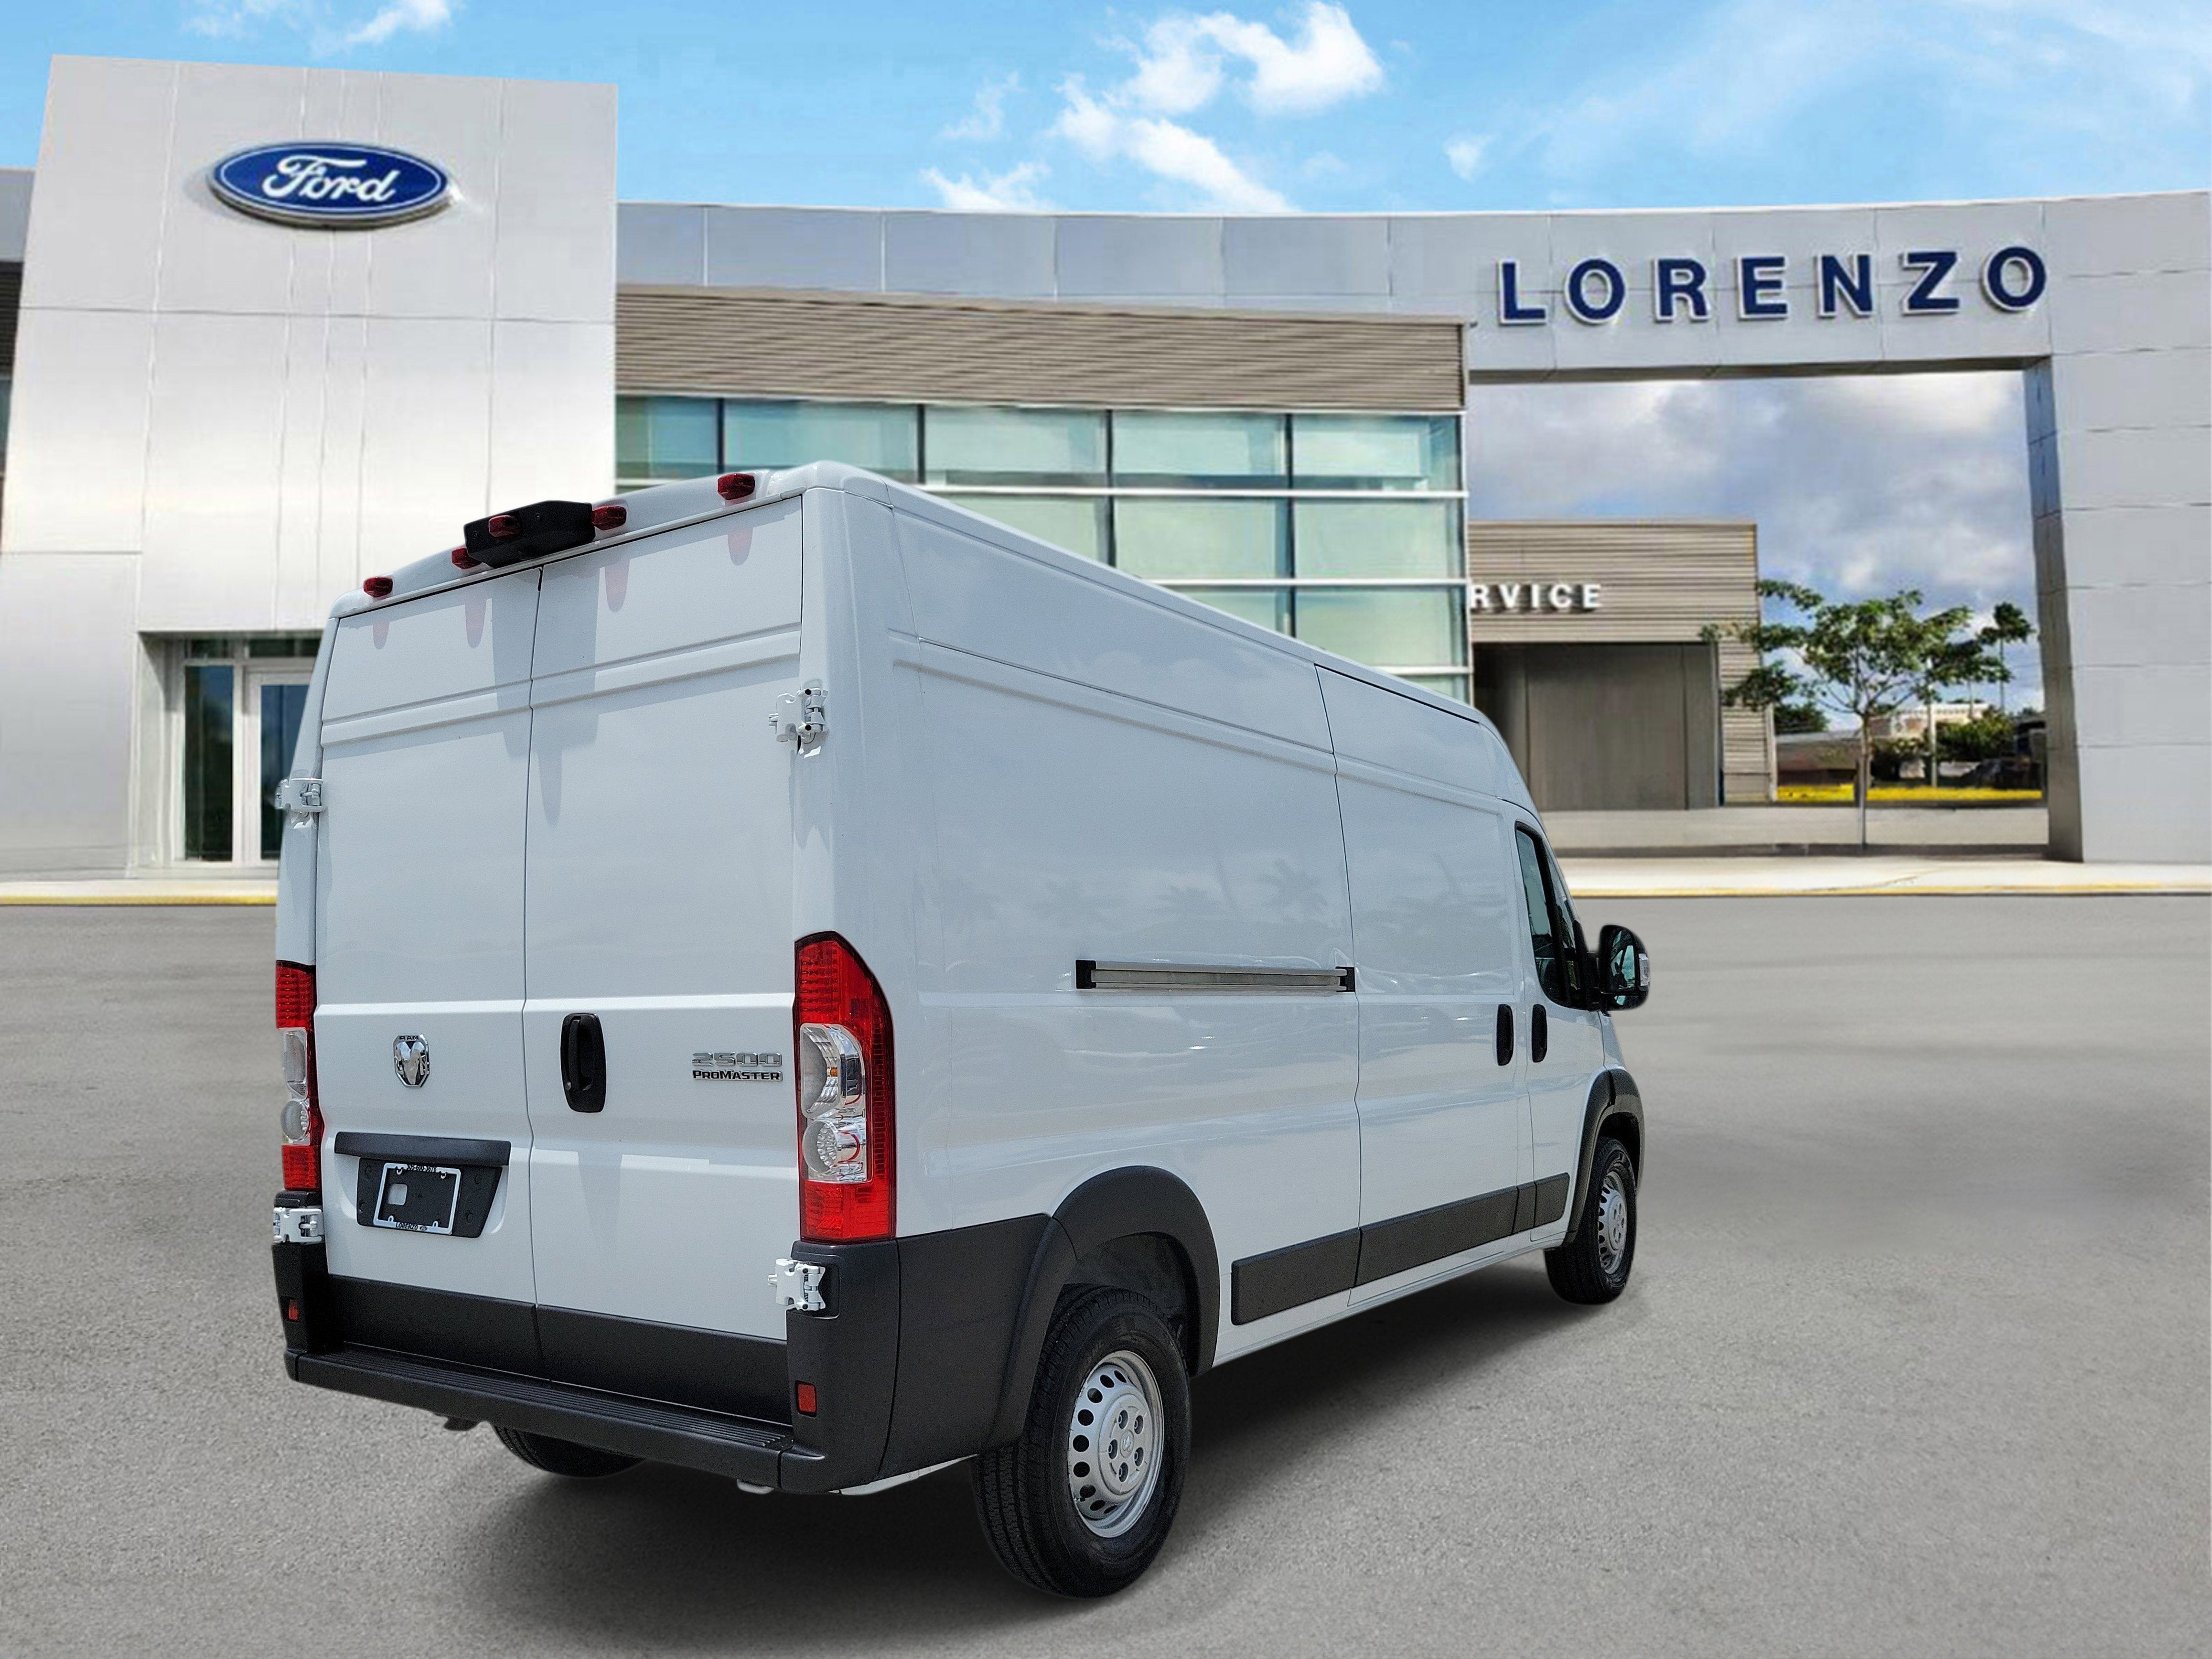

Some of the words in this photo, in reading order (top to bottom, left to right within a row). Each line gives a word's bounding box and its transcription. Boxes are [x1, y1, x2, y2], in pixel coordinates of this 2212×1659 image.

[262, 155, 400, 201] Ford
[1497, 247, 2047, 324] LORENZO
[692, 1052, 782, 1066] 2500
[396, 1222, 418, 1230] LORENZO
